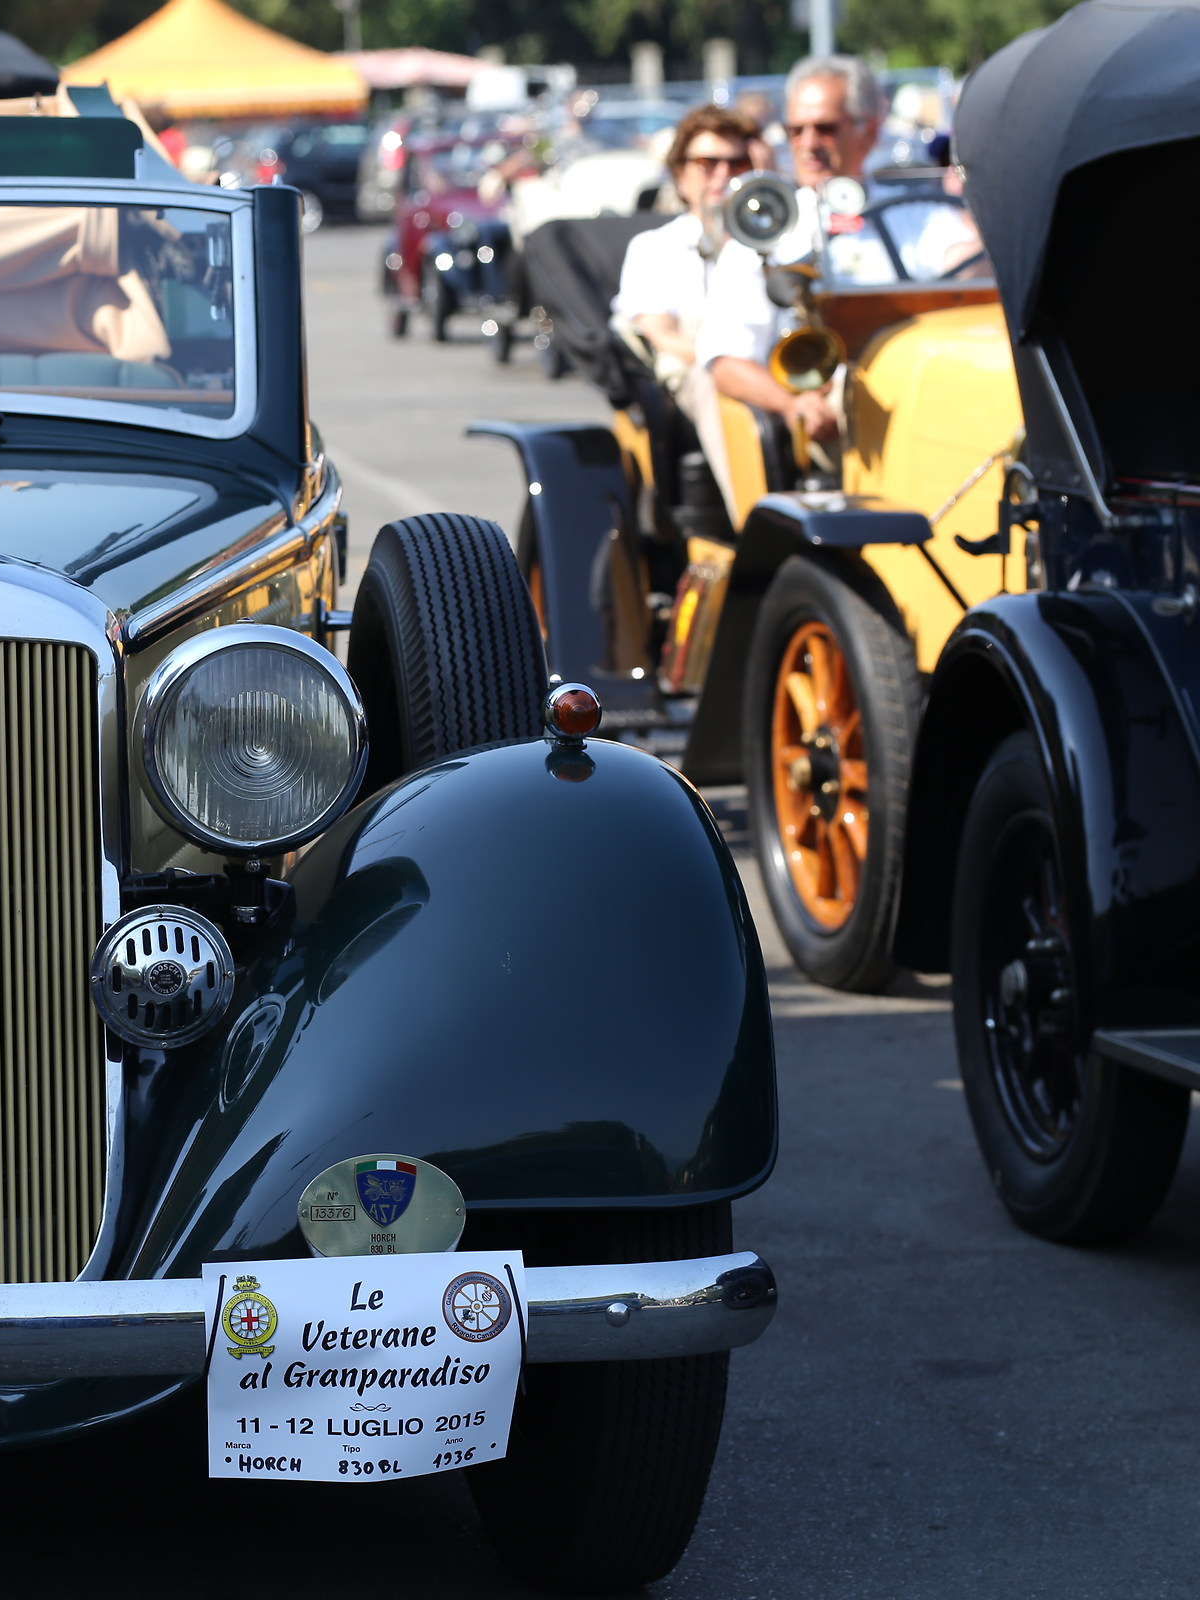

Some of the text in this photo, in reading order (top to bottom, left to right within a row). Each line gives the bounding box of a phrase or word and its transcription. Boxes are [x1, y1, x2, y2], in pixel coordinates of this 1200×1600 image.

[153, 964, 179, 975] BOSCH
[316, 1208, 352, 1218] 13376
[371, 1234, 396, 1242] HORCH
[371, 1245, 396, 1254] 830 BL
[351, 1281, 383, 1311] Le
[457, 1277, 494, 1286] Locomozione
[495, 1285, 506, 1303] Storica
[302, 1320, 436, 1352] Veterane
[452, 1322, 504, 1339] Rivarolo Canavese
[239, 1355, 490, 1396] al Granparadiso
[237, 1418, 259, 1433] 11
[287, 1418, 313, 1434] 12
[328, 1418, 423, 1436] LUGLIO
[435, 1411, 485, 1432] 2015
[343, 1445, 360, 1453] Tipo
[239, 1454, 301, 1473] HORCH
[433, 1447, 478, 1470] 1936
